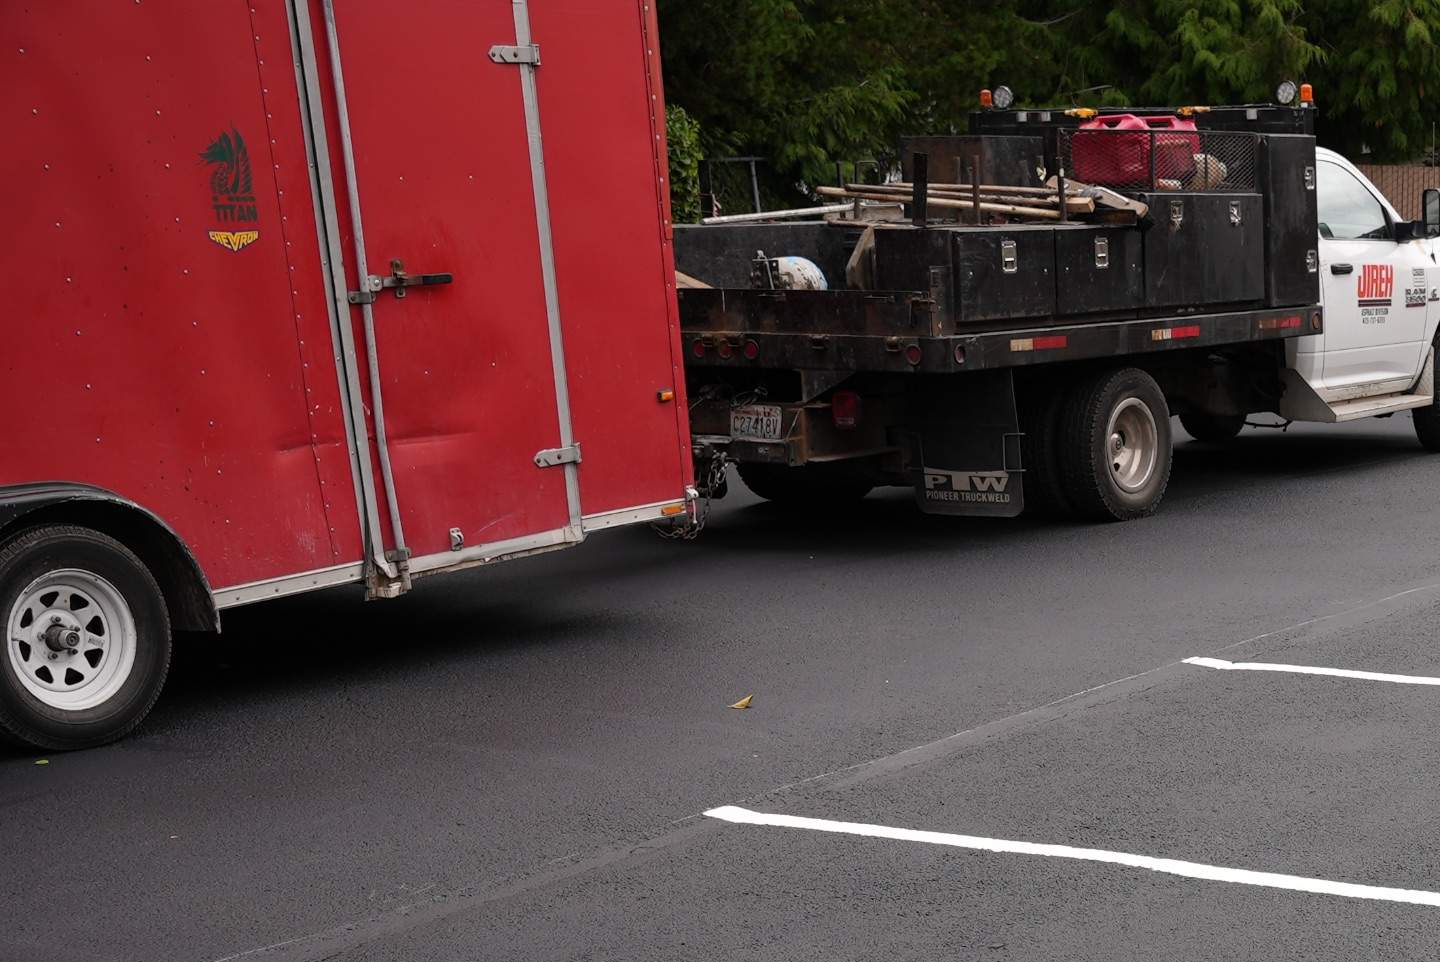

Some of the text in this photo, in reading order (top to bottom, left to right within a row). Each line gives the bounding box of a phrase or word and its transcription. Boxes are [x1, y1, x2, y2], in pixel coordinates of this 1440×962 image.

[213, 204, 259, 223] TITAN
[208, 230, 259, 251] CHEVRON
[1357, 264, 1393, 298] JIREH
[733, 415, 778, 435] C27418V
[924, 467, 1009, 493] PTW
[926, 490, 1010, 503] PIONEER TRUCKWELD
